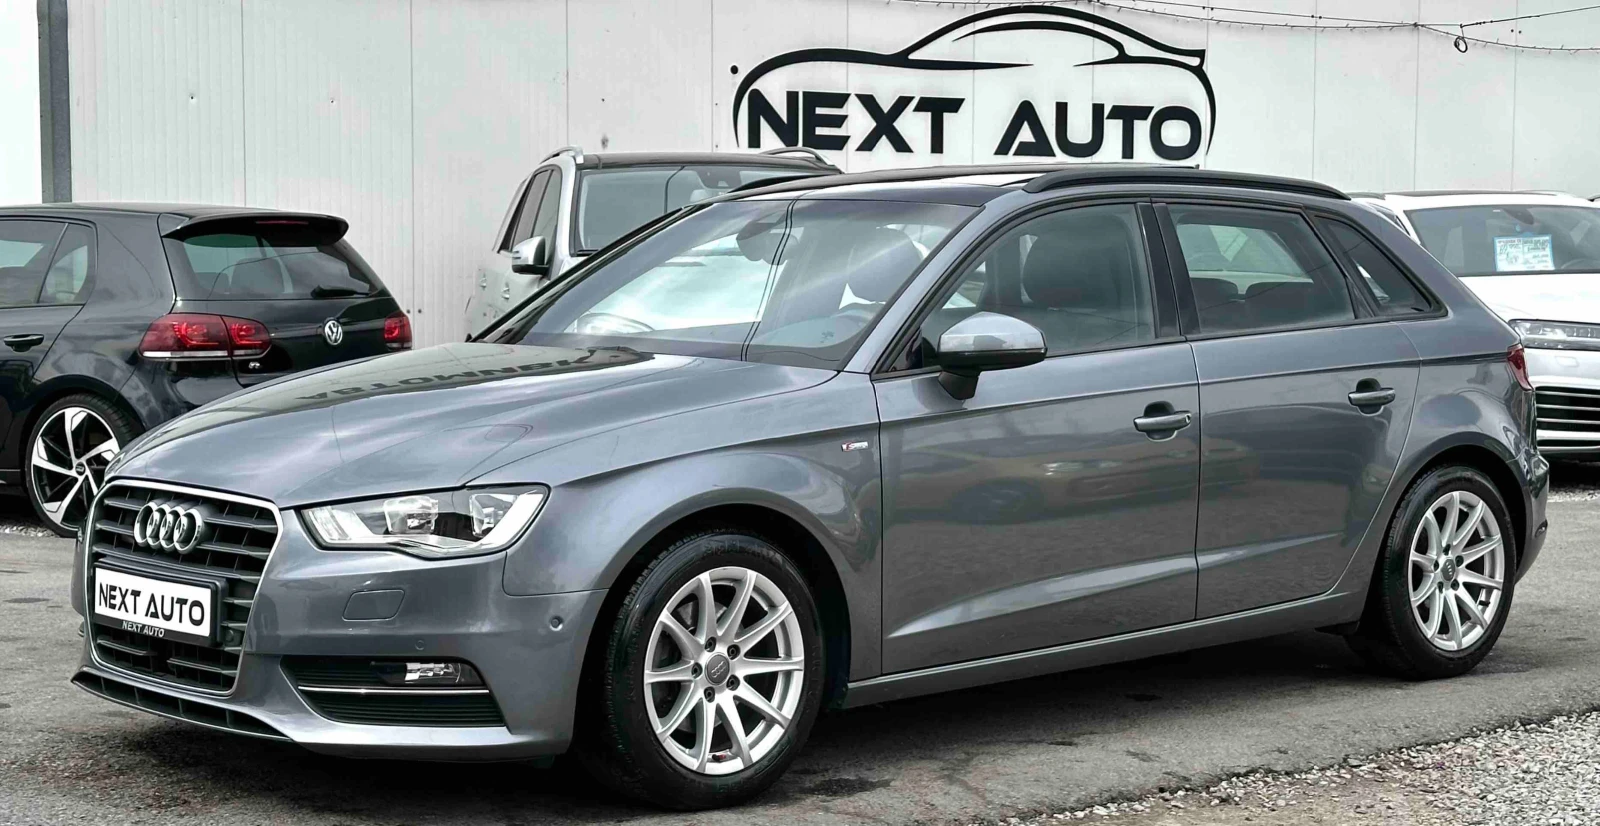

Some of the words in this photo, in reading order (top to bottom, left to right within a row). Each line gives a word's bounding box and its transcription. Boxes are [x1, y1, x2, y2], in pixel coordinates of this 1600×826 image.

[748, 88, 966, 154] NEXT
[993, 100, 1202, 161] AUTO
[99, 582, 142, 615] NEXT
[144, 593, 205, 626] AUTO
[122, 620, 143, 633] NEXT
[143, 626, 165, 637] AUTO
